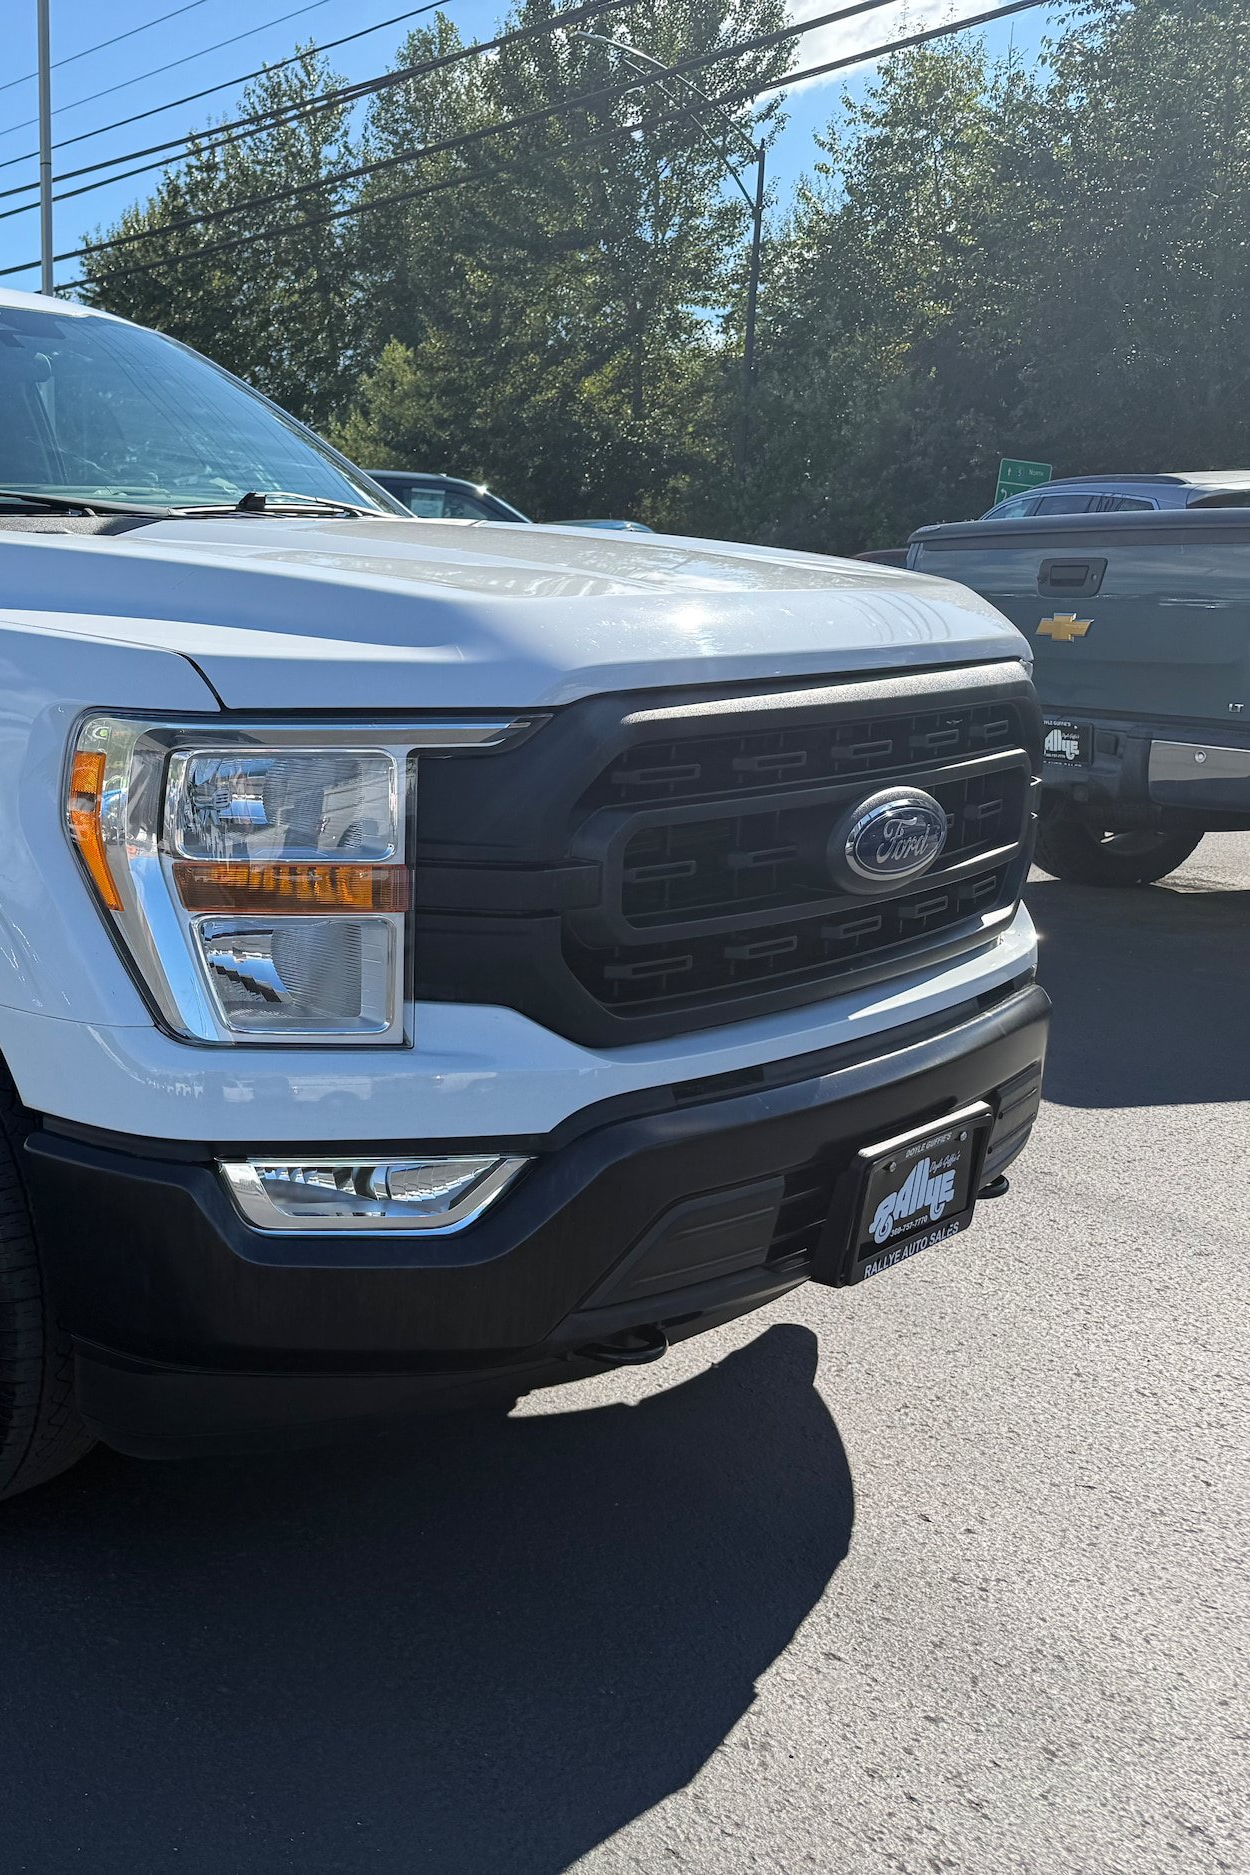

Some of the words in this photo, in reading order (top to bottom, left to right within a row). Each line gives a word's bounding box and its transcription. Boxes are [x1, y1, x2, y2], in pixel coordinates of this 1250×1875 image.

[1228, 703, 1245, 713] LT
[876, 817, 931, 864] Ford
[905, 1142, 927, 1158] DOYLE
[864, 1249, 902, 1279] RALLYE
[901, 1237, 928, 1260] AUTO
[929, 1221, 960, 1246] SALES
